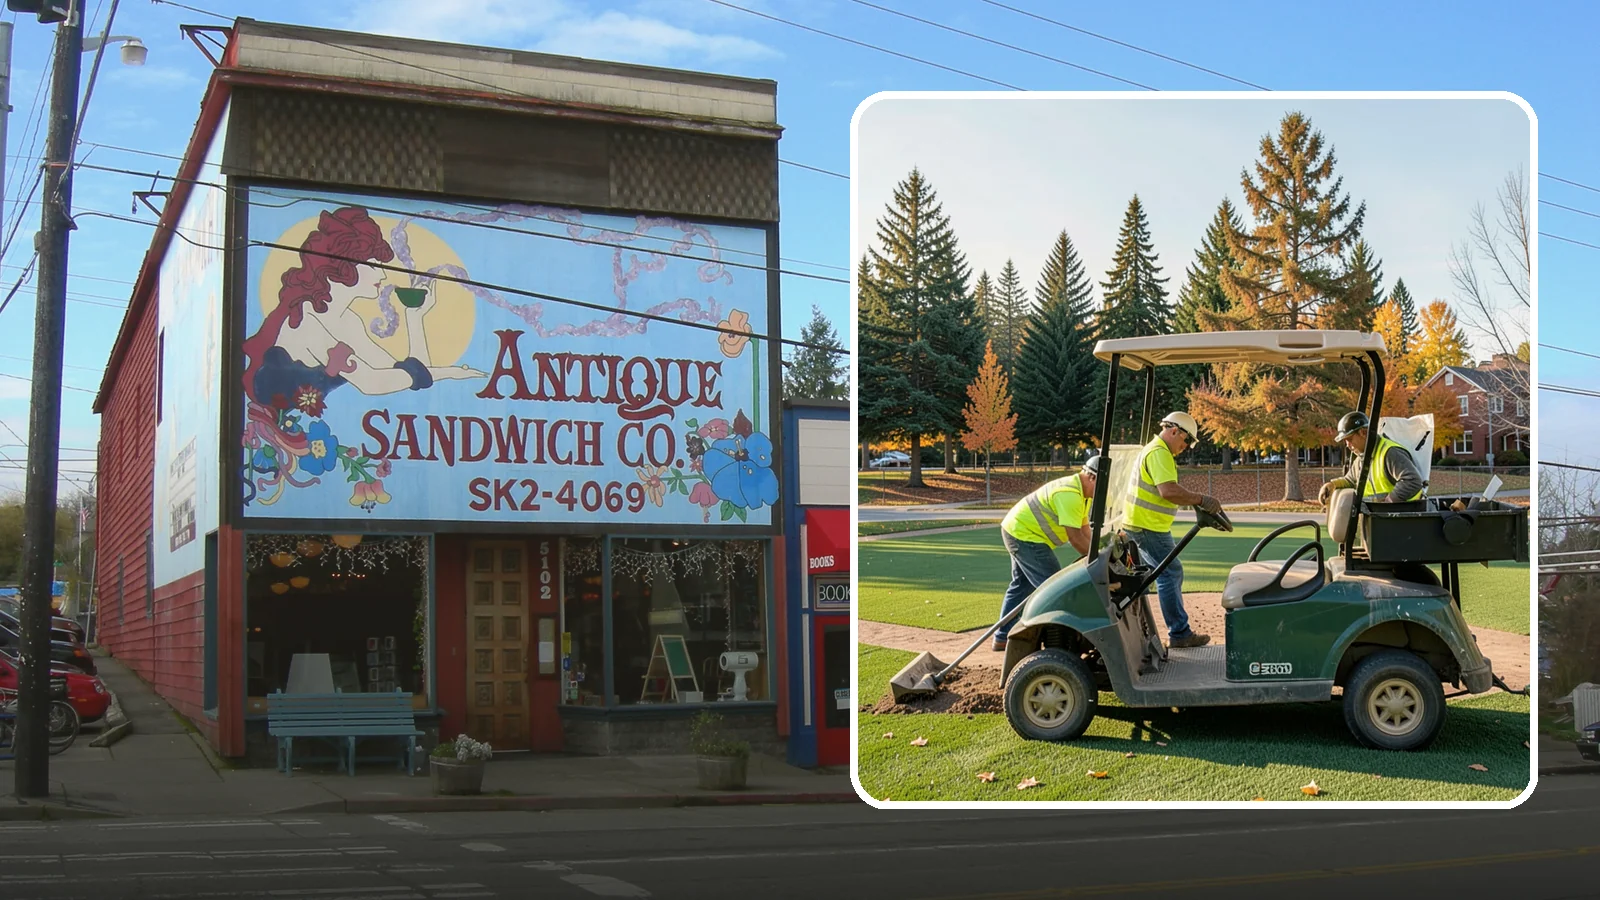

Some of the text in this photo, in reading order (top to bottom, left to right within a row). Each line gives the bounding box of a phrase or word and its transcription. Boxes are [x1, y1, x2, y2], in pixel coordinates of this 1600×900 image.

[475, 328, 724, 421] ANTIQUE
[361, 408, 685, 470] SANDWICH CO.
[468, 477, 646, 513] SK2-4069
[540, 541, 551, 599] 5102
[809, 555, 834, 569] BOOKS
